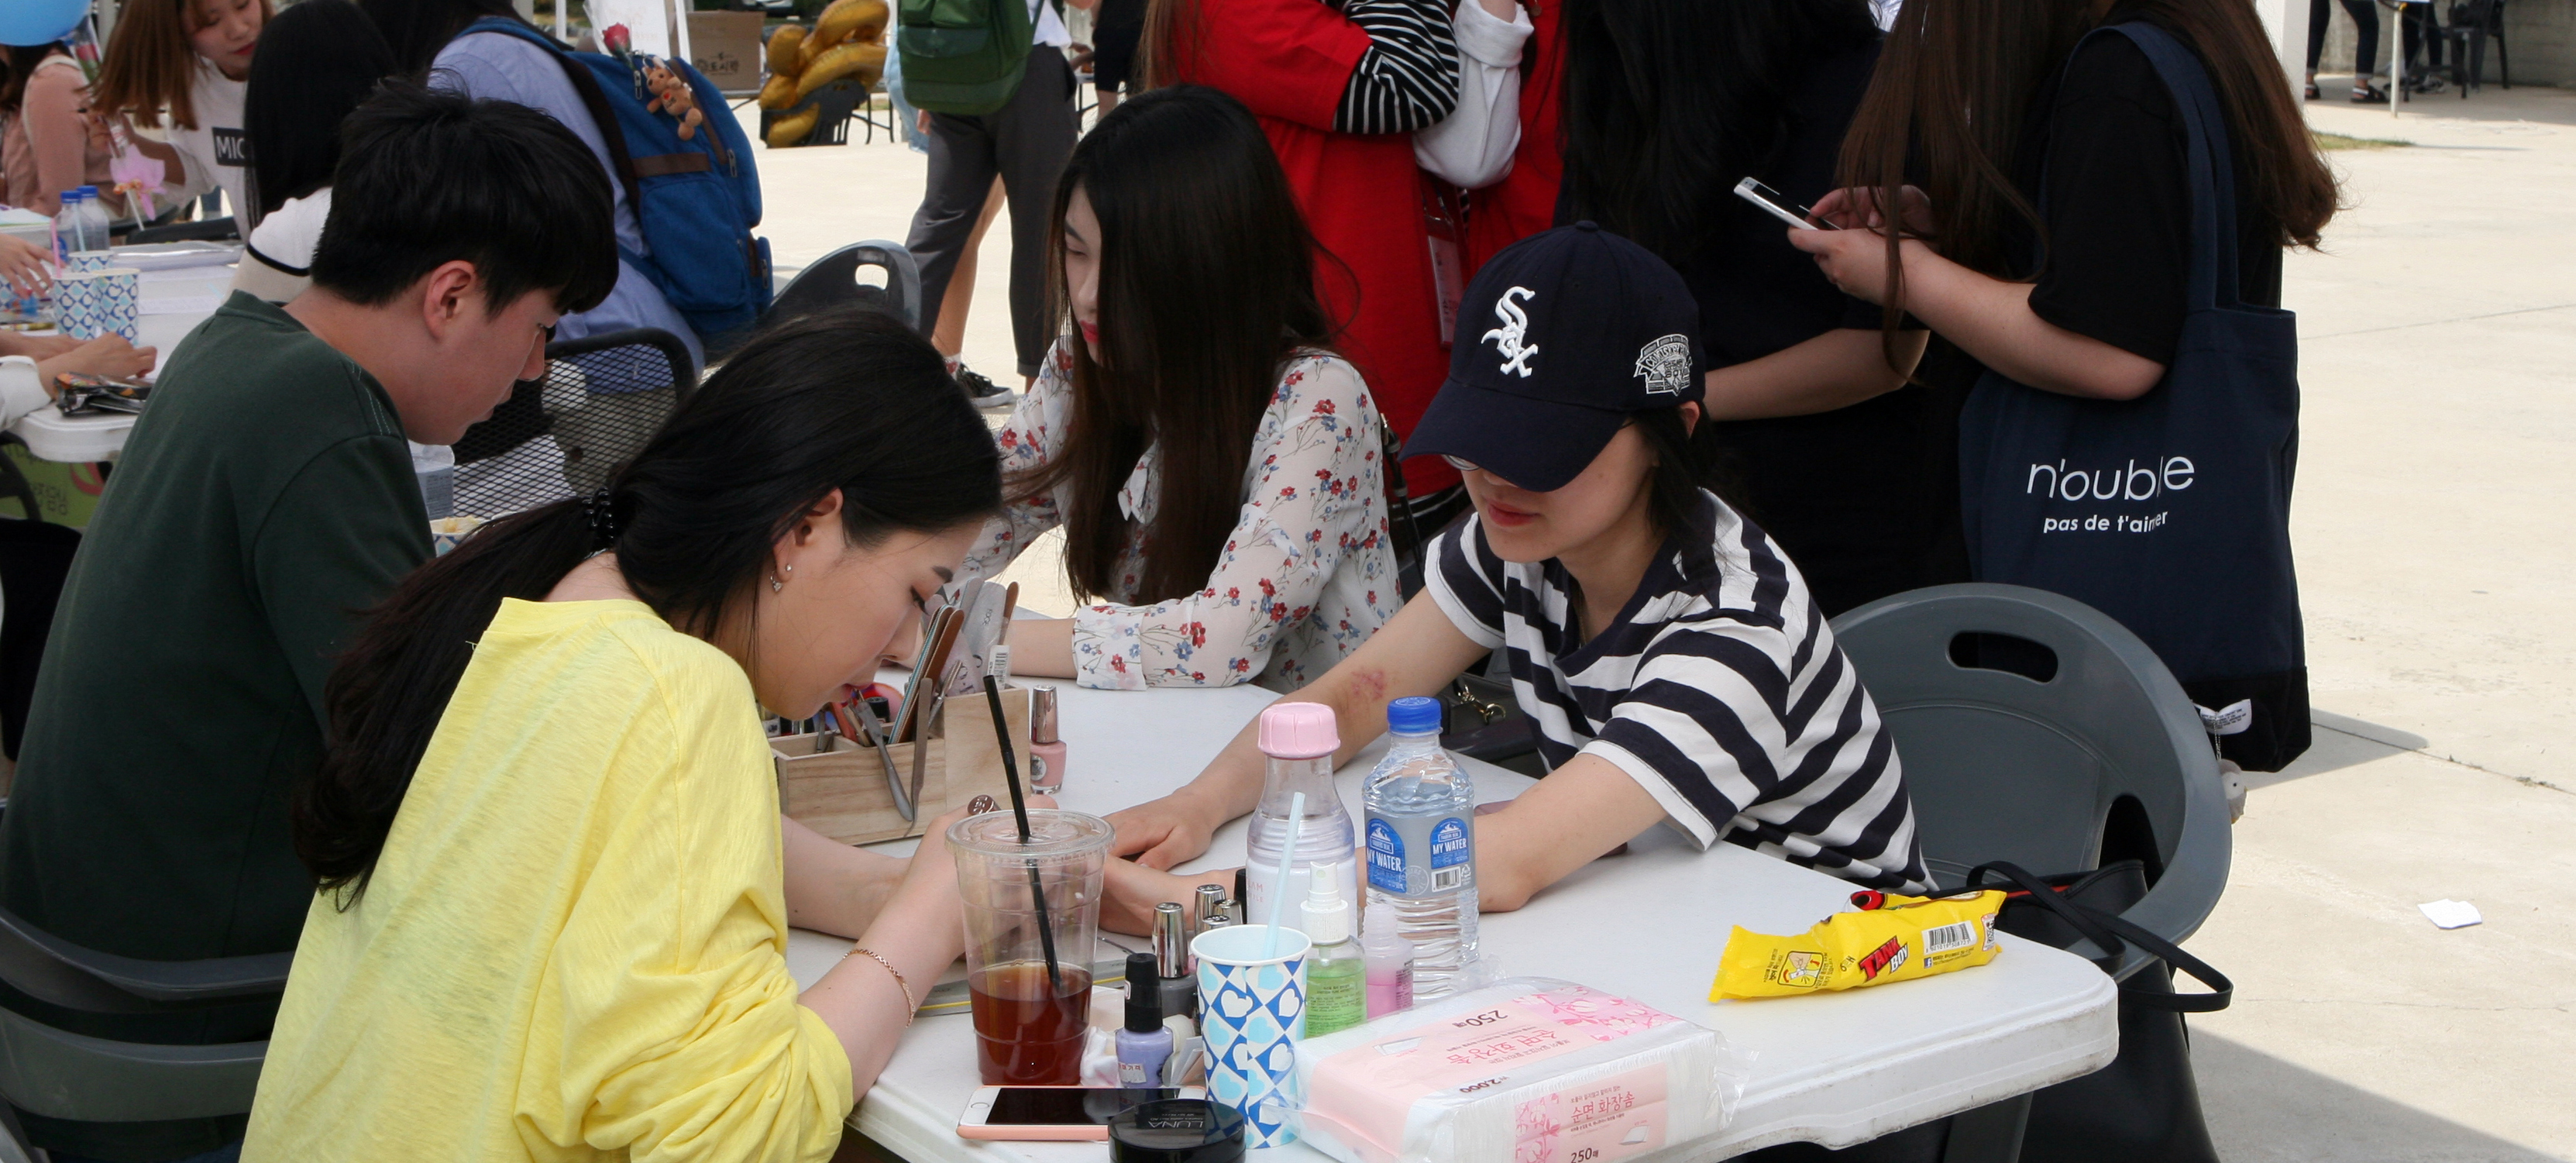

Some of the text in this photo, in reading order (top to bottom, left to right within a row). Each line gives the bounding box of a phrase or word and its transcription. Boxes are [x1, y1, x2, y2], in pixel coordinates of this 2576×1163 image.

[2043, 518, 2078, 534] pas
[2084, 514, 2110, 531] de
[1432, 838, 1467, 855] MY WATER
[1376, 852, 1401, 872] WATER
[1859, 935, 1901, 982] TANK
[1889, 942, 1908, 975] BOY
[1511, 1030, 1556, 1046] 순면
[1446, 1041, 1517, 1064] 화장솜
[1571, 1101, 1594, 1123] 순면
[1598, 1091, 1635, 1113] 화장솜
